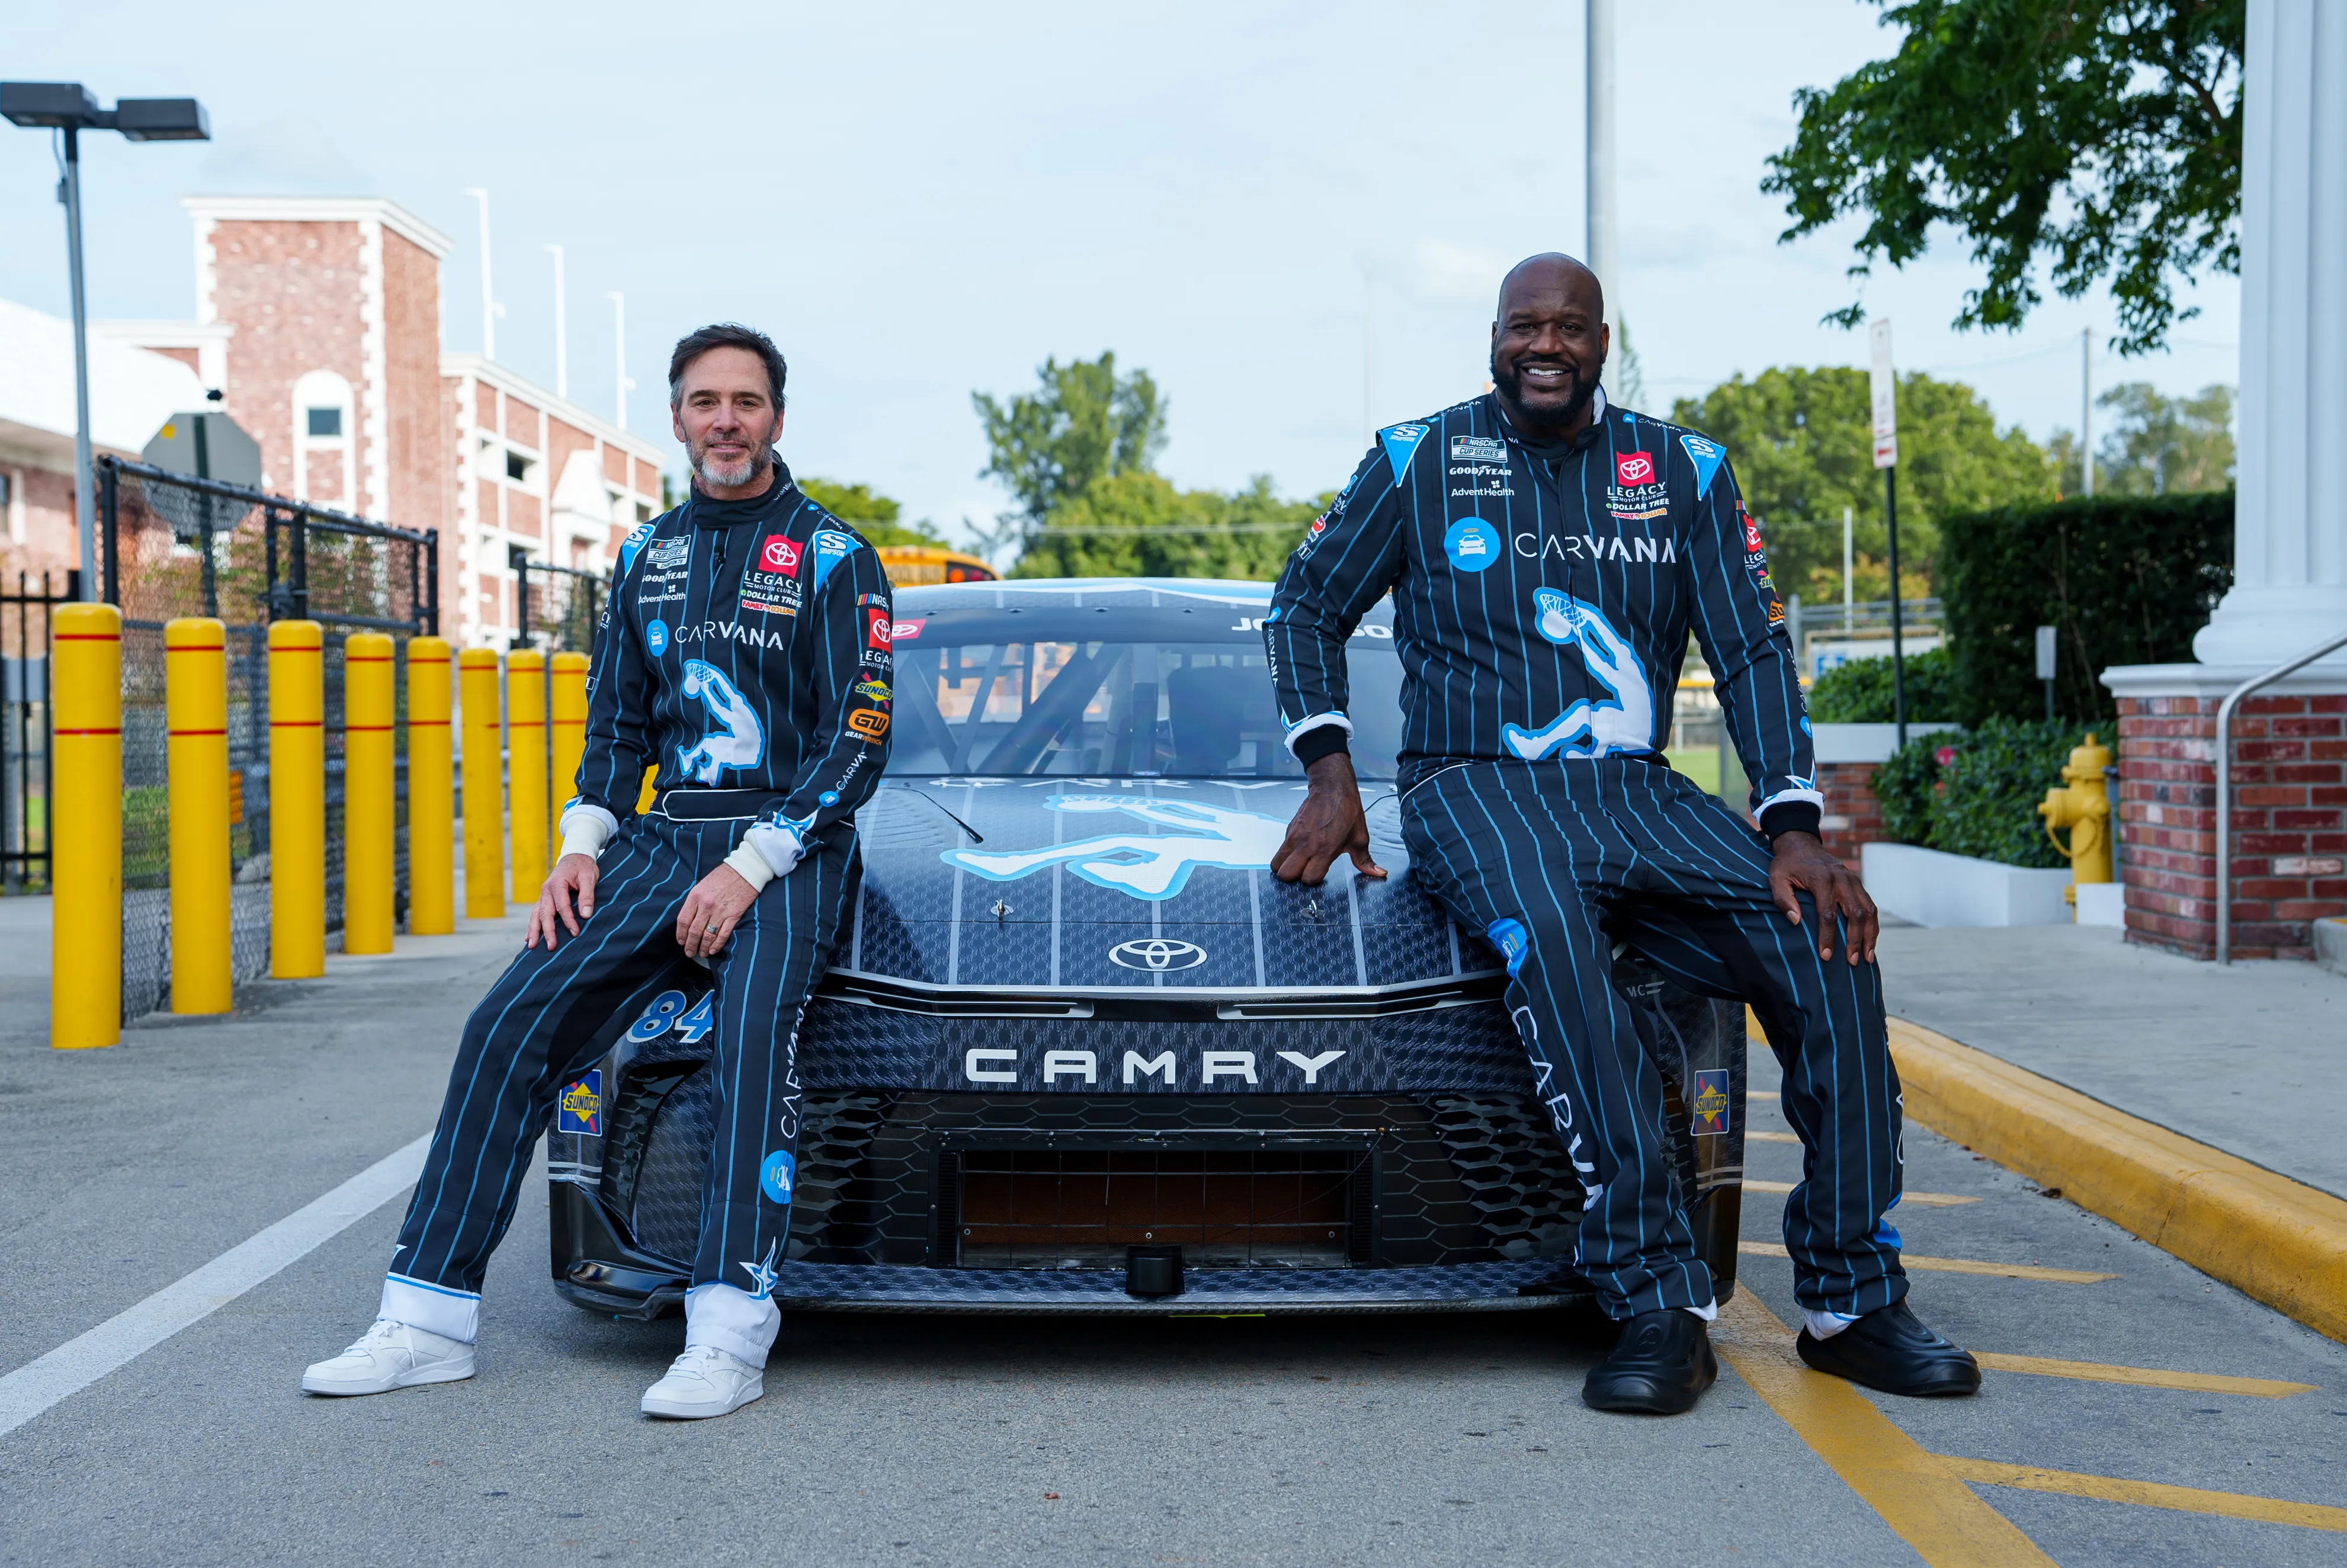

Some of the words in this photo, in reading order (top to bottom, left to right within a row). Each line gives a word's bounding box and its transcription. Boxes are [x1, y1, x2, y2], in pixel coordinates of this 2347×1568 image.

[1469, 439, 1498, 448] NASCAR
[1459, 447, 1473, 456] CUP
[1474, 448, 1499, 457] SERIES
[1449, 465, 1512, 477] GOODYEAR
[1451, 488, 1515, 497] AdventHealth
[1607, 481, 1666, 498] LEGACY
[1649, 498, 1670, 509] TREE
[816, 510, 844, 530] CARVANA
[1610, 511, 1635, 520] FAMILY
[1639, 508, 1668, 520] DOLLAR
[819, 547, 845, 558] SIMPSON
[1514, 533, 1676, 563] CARVANA
[744, 570, 803, 593] LEGACY
[637, 592, 686, 605] AdventHealth
[746, 590, 780, 602] DOLLAR
[781, 595, 803, 608] TREE
[741, 599, 765, 611] FAMILY
[770, 605, 796, 617] DOLLAR
[675, 621, 784, 650] CARVANA
[858, 684, 893, 699] SUNOCO
[627, 989, 715, 1044] 84
[966, 1048, 1346, 1084] CAMRY
[565, 1094, 598, 1112] SUNOCO
[1697, 1096, 1725, 1112] SUNOCO
